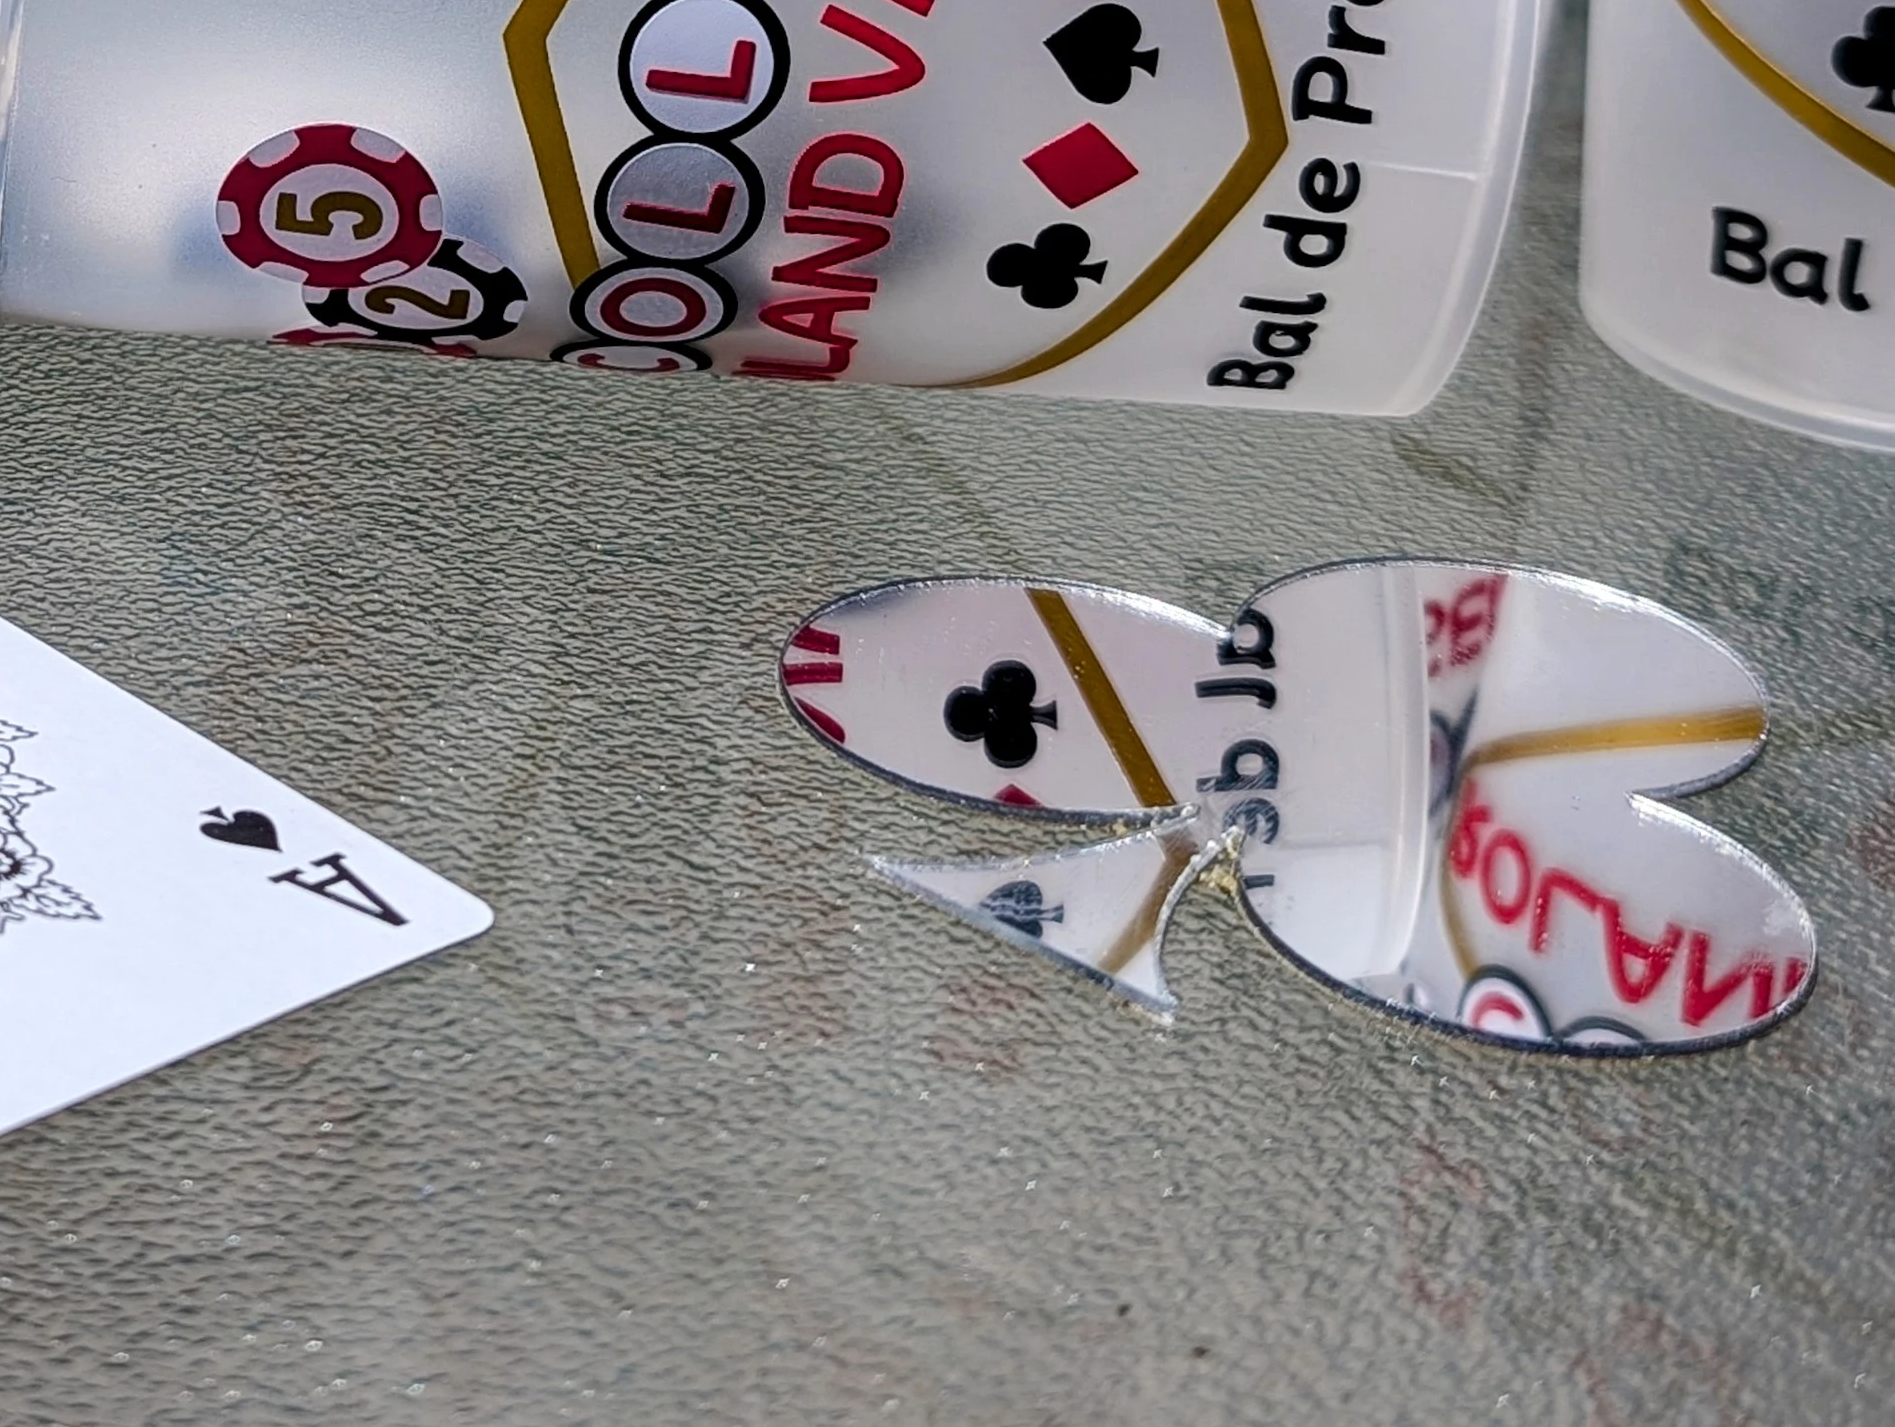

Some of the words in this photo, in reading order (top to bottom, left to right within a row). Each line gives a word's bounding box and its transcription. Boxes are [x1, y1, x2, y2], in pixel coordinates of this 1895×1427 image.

[274, 189, 384, 242] 5
[364, 284, 472, 322] 2
[732, 132, 906, 381] LAND
[1262, 156, 1362, 270] de
[1708, 205, 1872, 314] Bal
[1206, 291, 1328, 391] Bal
[270, 853, 414, 930] A
